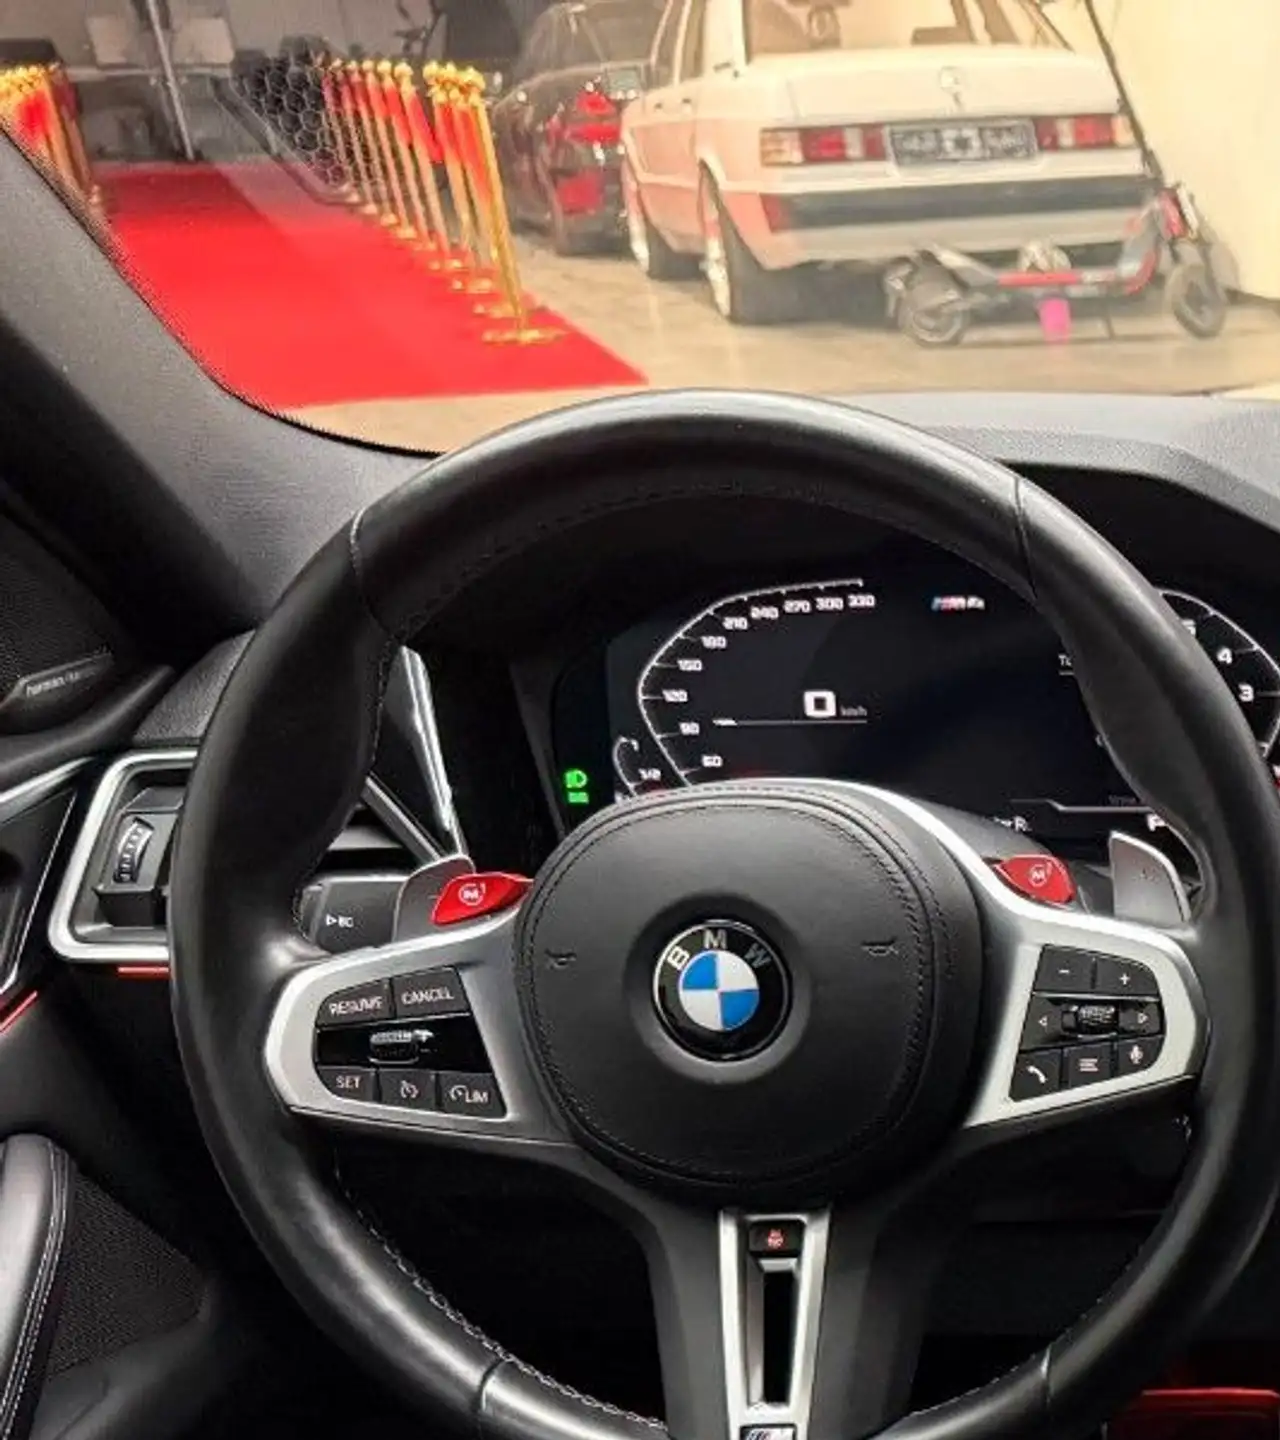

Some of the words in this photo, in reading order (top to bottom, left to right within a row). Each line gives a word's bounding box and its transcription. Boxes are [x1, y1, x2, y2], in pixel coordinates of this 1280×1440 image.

[1217, 648, 1232, 664] 4
[1239, 684, 1254, 702] 3
[667, 928, 771, 970] BMW
[402, 987, 455, 1005] CANCEL
[329, 996, 383, 1015] RESUME
[336, 1075, 361, 1089] SET
[465, 1088, 488, 1103] LIM
